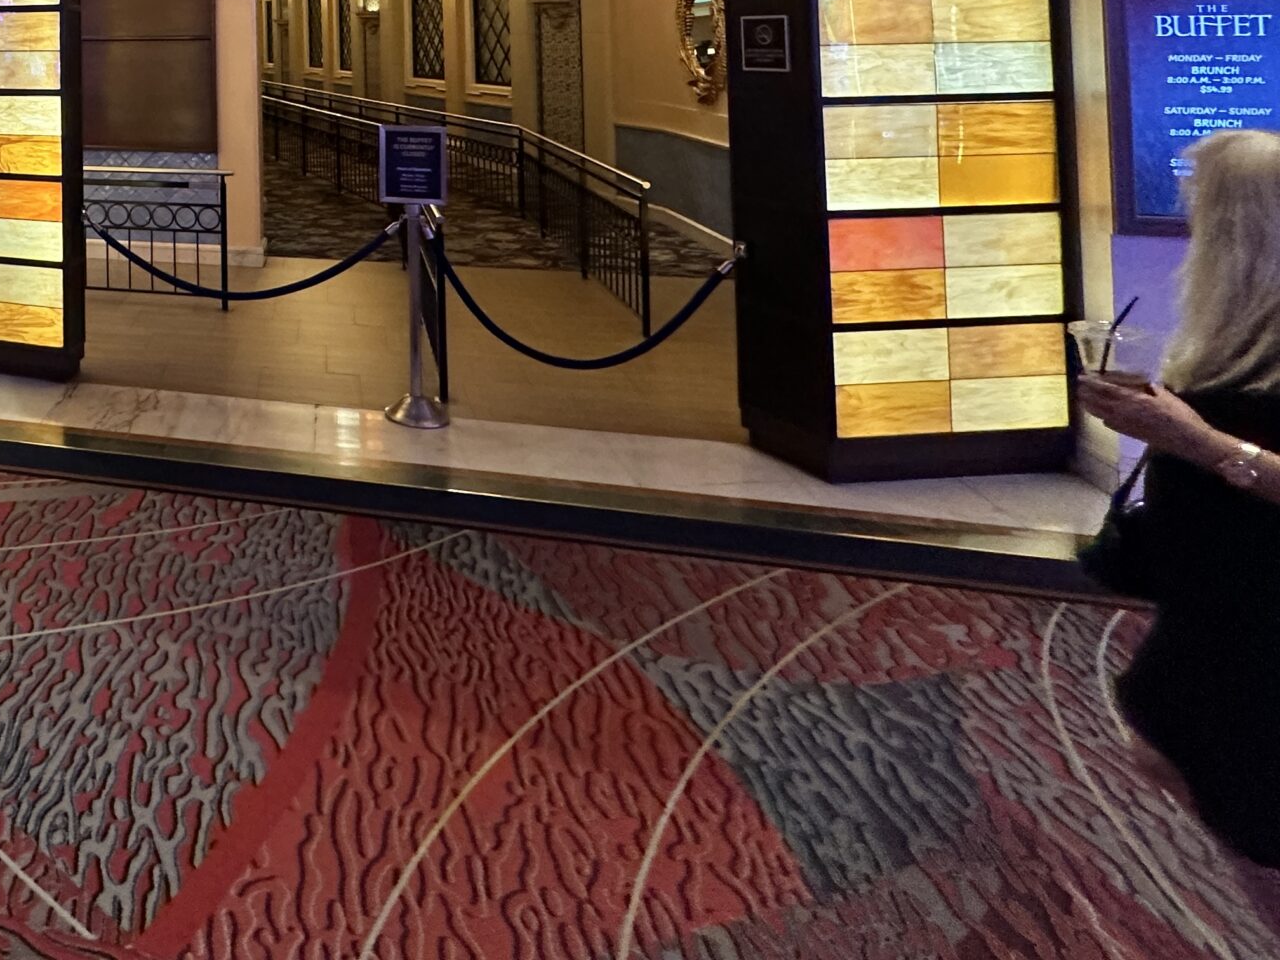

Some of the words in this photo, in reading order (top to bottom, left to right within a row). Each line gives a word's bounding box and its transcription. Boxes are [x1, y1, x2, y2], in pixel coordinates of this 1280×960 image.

[1196, 4, 1229, 13] THE
[1154, 14, 1273, 37] BUFFET
[1168, 54, 1213, 62] MONDAY
[1225, 54, 1262, 62] FRIDAY
[1191, 66, 1240, 75] BRUNCH
[1164, 106, 1217, 115] SATURDAY
[1228, 107, 1272, 116] SUNDAY
[1193, 118, 1243, 128] BRUNCH
